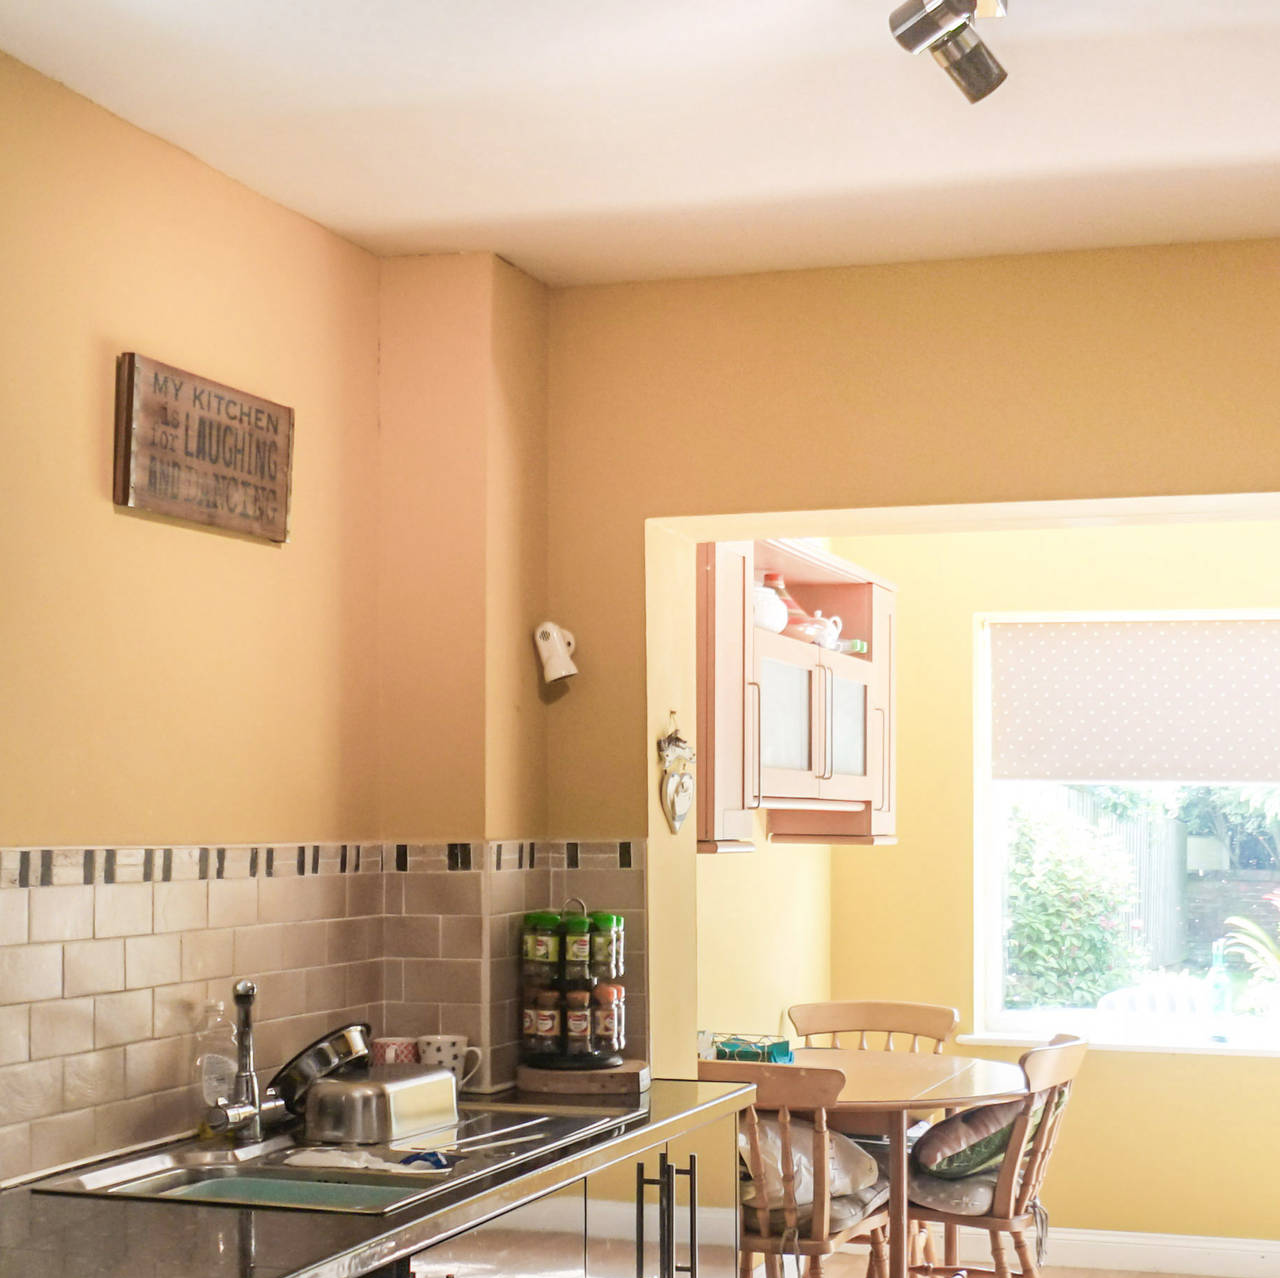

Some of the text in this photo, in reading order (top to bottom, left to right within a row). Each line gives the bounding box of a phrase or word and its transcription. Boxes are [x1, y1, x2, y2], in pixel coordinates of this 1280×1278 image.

[153, 372, 279, 436] MY KITCHEN
[160, 402, 181, 430] is
[150, 411, 279, 482] for LAUGHING
[148, 456, 279, 525] AND DANCING
